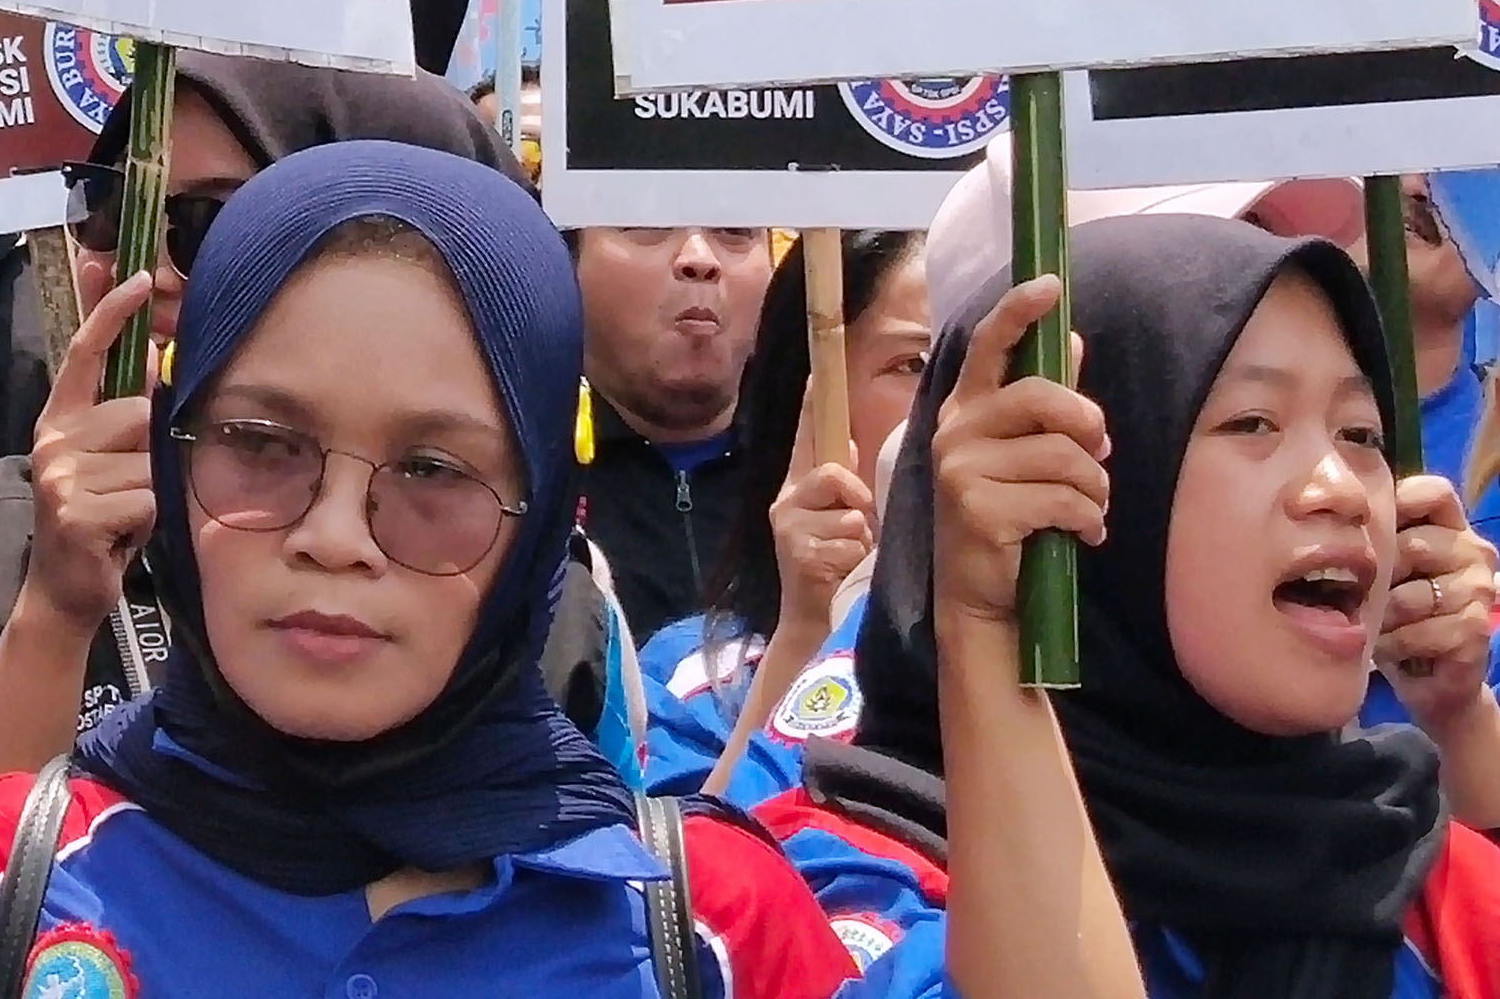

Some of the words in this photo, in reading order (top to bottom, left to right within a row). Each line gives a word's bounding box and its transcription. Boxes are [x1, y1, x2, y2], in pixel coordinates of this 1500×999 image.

[55, 28, 84, 90] BUR
[634, 90, 814, 119] SUKABUMI
[863, 90, 926, 144] SAYA
[84, 685, 103, 708] SP
